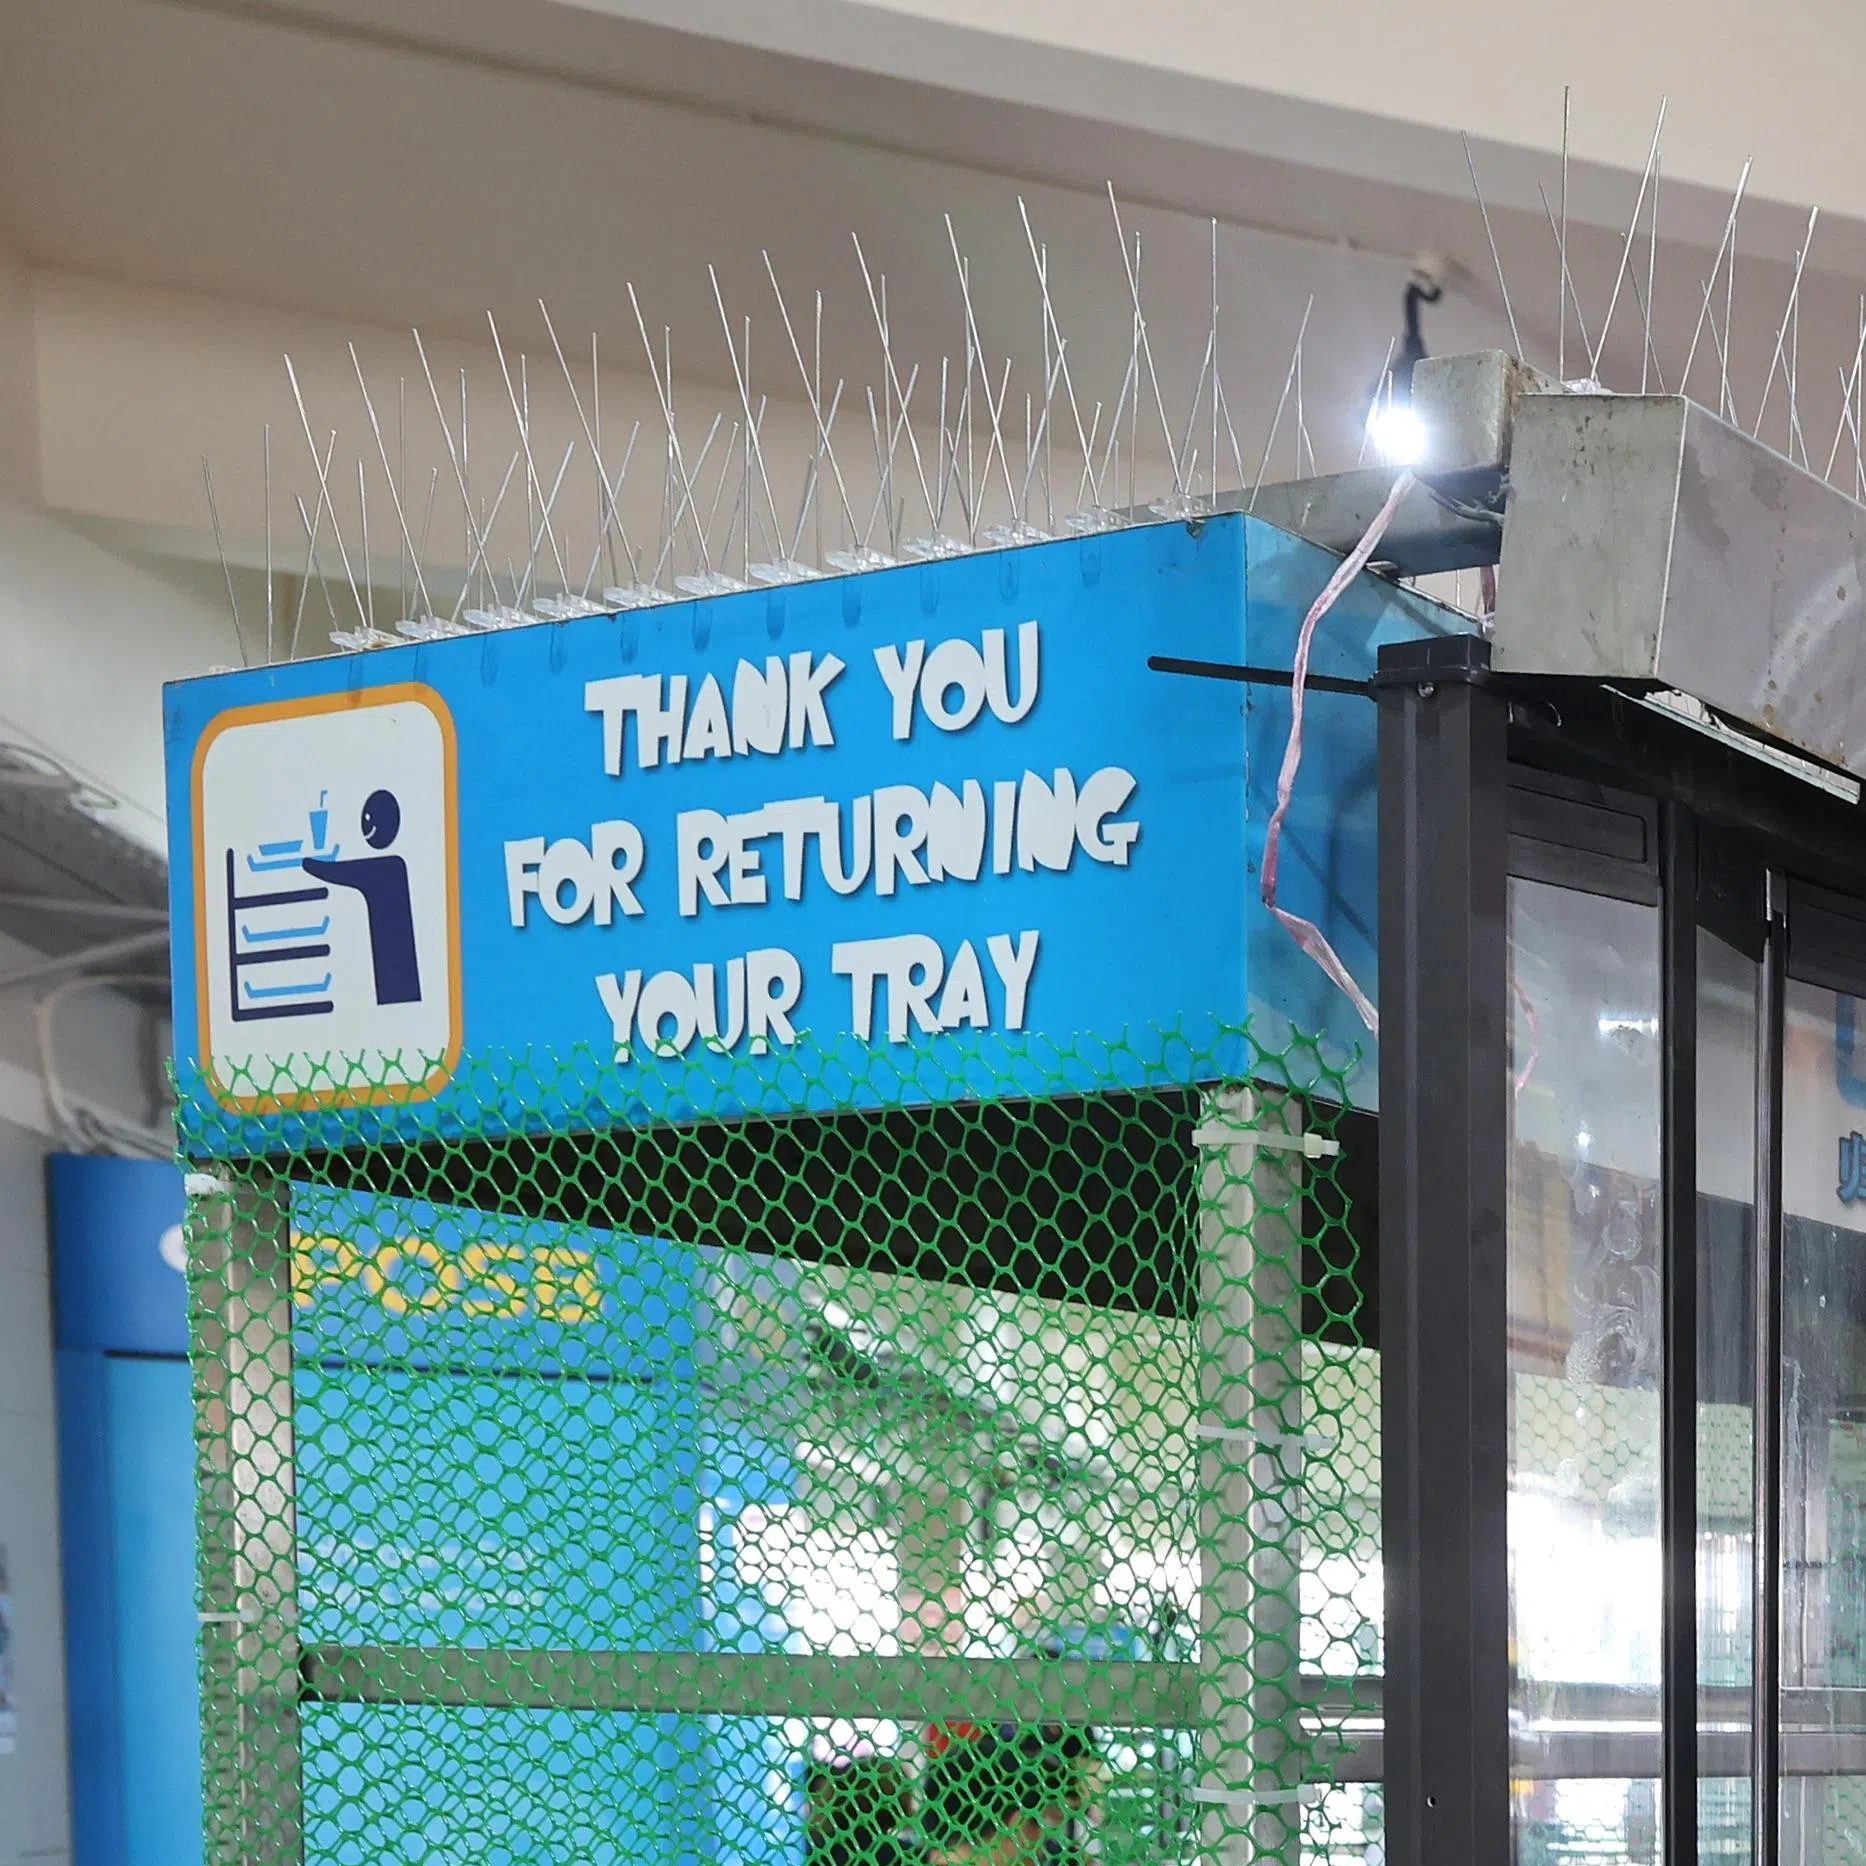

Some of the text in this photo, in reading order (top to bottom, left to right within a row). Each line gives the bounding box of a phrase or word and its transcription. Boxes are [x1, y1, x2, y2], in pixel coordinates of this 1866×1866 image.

[583, 620, 1039, 776] THANK YOU
[503, 766, 1140, 927] FOR RETURNING
[595, 930, 1040, 1064] YOUR TRAY
